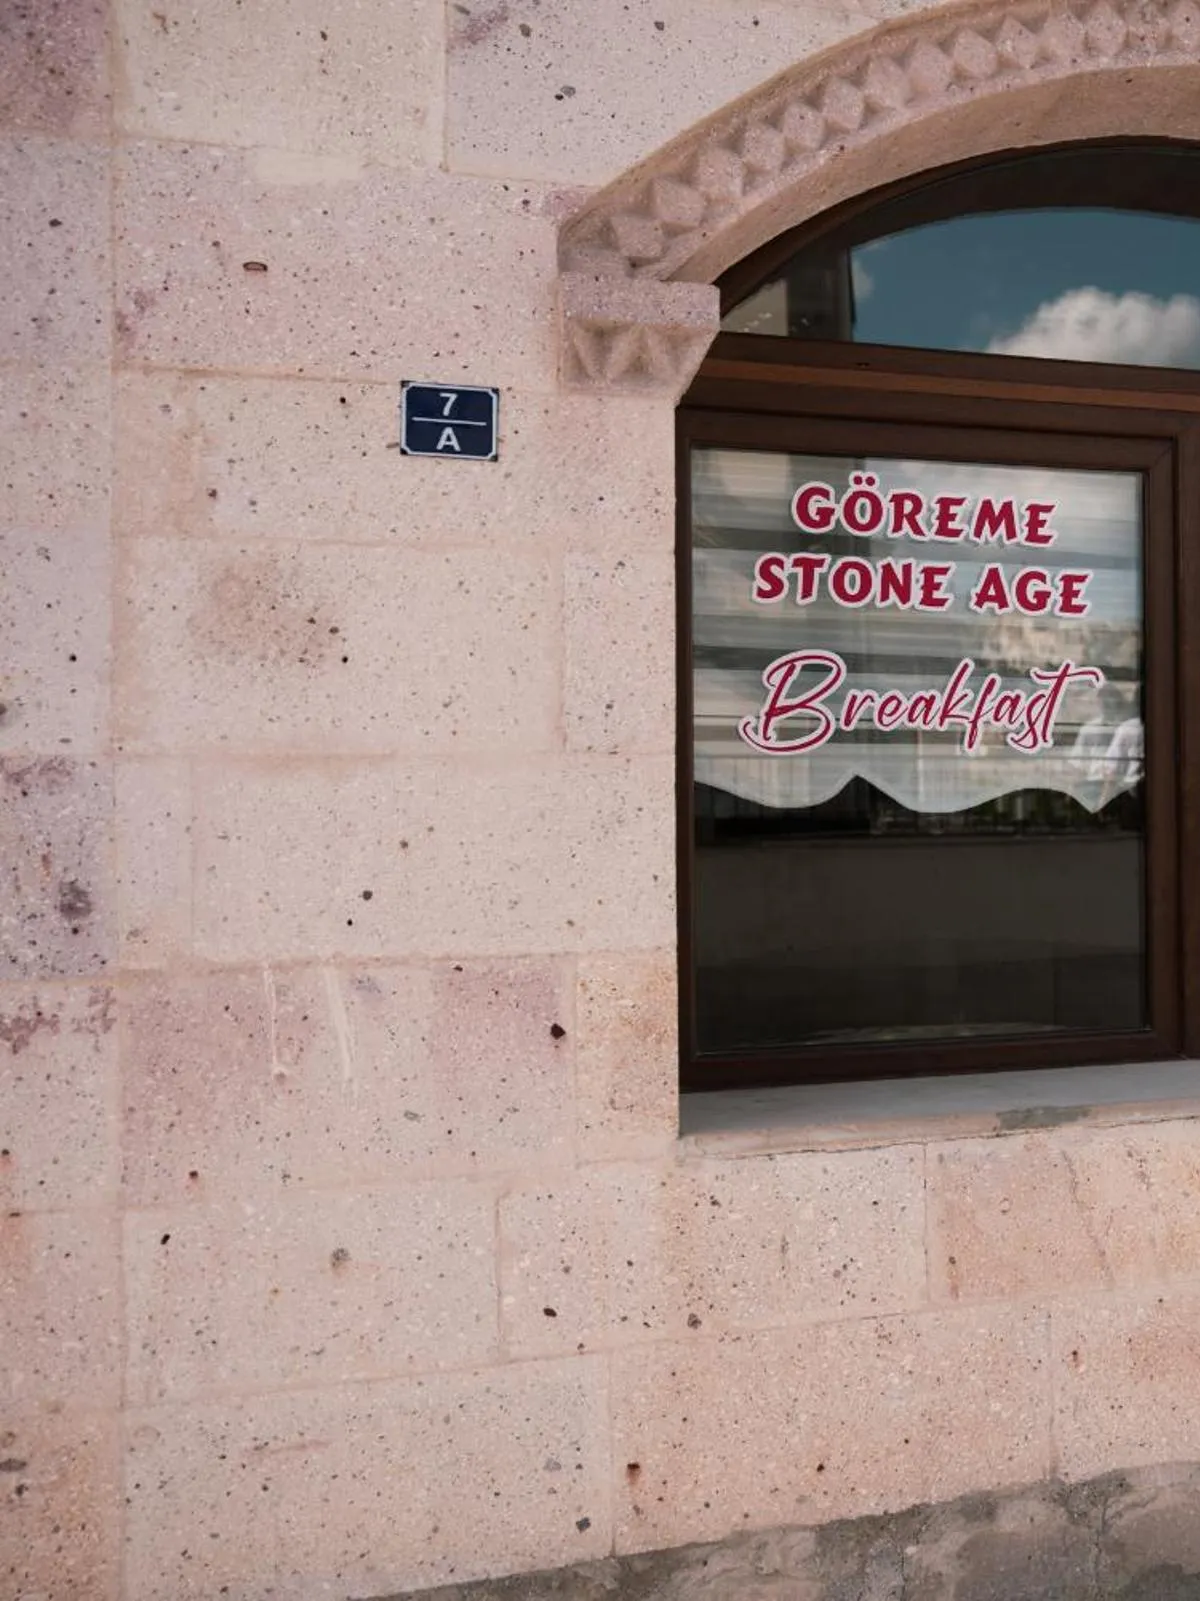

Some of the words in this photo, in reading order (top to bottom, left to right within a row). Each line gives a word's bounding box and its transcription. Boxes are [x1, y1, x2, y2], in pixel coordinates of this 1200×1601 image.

[439, 392, 459, 417] 7
[435, 426, 462, 452] A
[793, 473, 1057, 545] GÖREME
[754, 556, 955, 609] STONE
[974, 566, 1091, 614] AGE
[741, 653, 1102, 752] Breakfast
